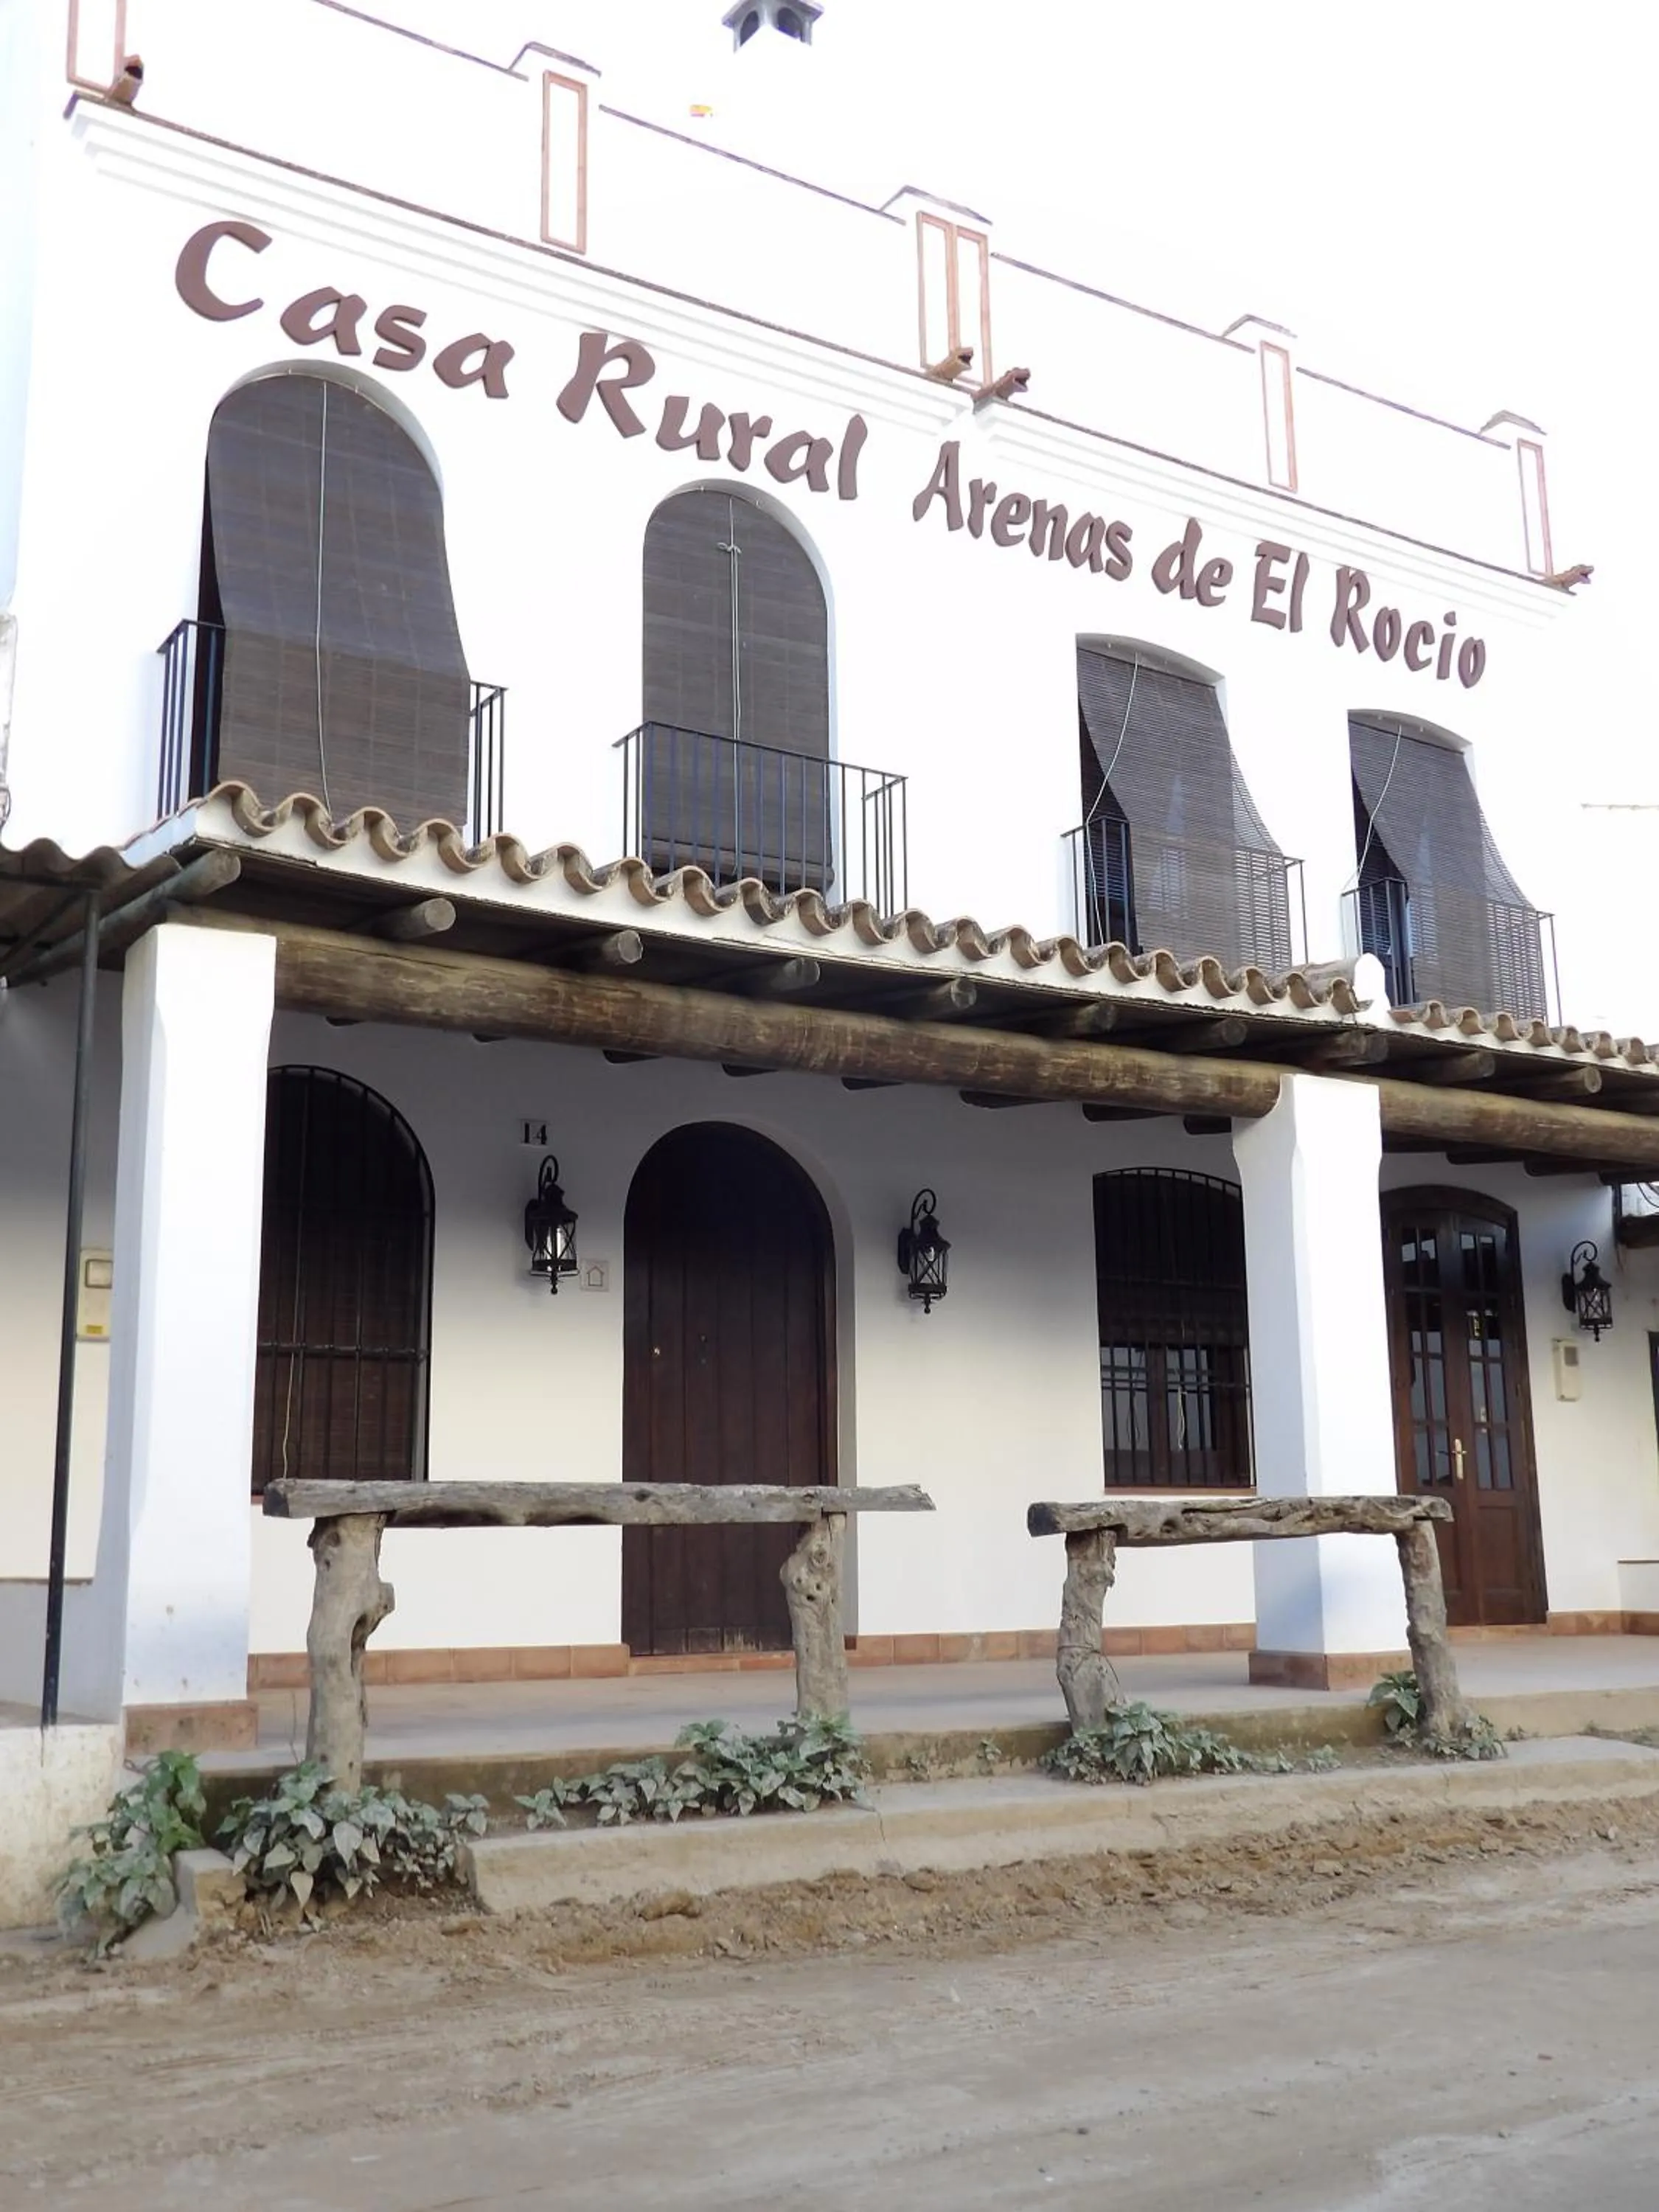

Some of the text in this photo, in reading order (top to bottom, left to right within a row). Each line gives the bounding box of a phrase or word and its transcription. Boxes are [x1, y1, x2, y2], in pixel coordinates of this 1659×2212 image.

[175, 220, 1486, 689] Casa Rural Arenas de El Rocio
[523, 1122, 548, 1145] 14
